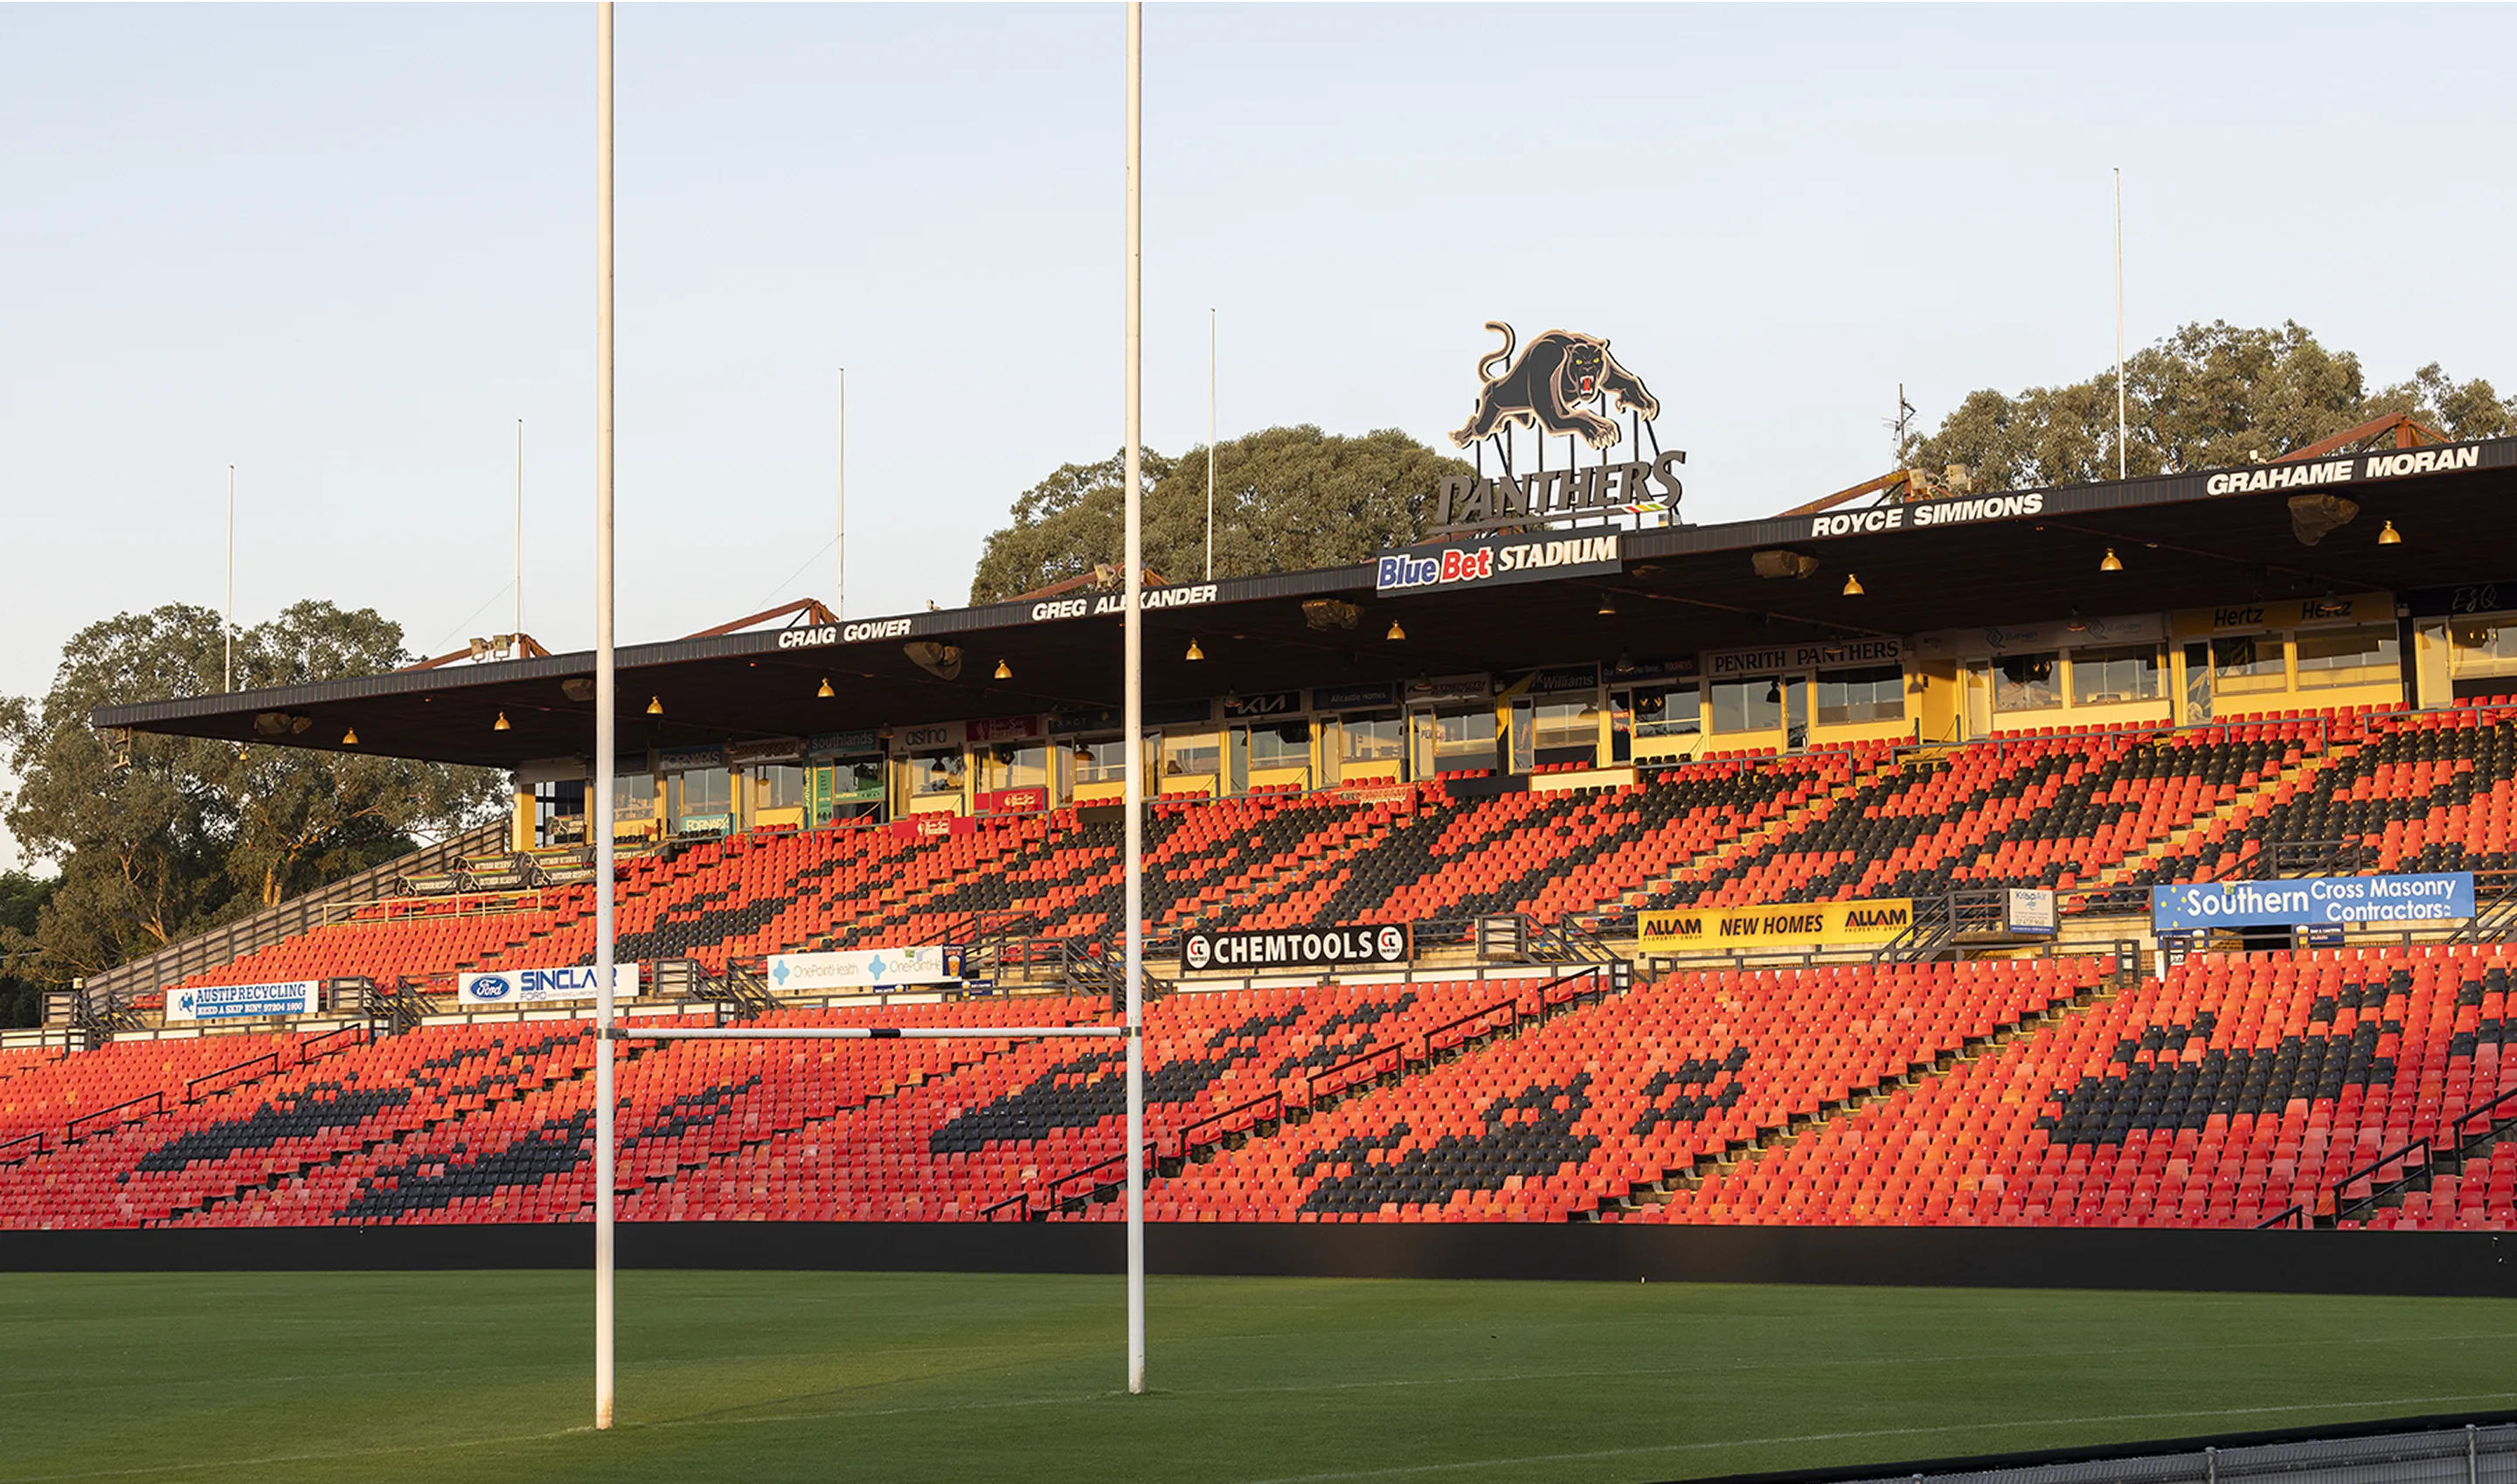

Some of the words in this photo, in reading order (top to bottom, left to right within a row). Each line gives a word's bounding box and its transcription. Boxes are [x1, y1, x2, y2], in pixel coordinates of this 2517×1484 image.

[2206, 460, 2354, 496] GRAHAME
[2366, 446, 2479, 478] MORAN
[1437, 450, 1686, 525] PANTHERS
[1811, 508, 1903, 537] ROYCE
[1914, 493, 2043, 525] SIMMONS
[1497, 536, 1618, 572] STADIUM
[1031, 599, 1087, 621] GREG
[2214, 607, 2264, 627] Hertz
[778, 626, 836, 648] CRAIG
[843, 619, 912, 641] GOWER
[1715, 650, 1786, 672] PENRITH
[1362, 691, 1387, 702] Homes
[811, 732, 874, 750] southlands
[2187, 886, 2309, 917] Southern
[2311, 881, 2364, 900] Cross
[2370, 878, 2457, 900] Masonry
[1845, 909, 1907, 927] ALLAM
[2326, 902, 2442, 922] Contractors
[1643, 919, 1702, 936] ALLAM
[1720, 919, 1759, 937] NEW
[1763, 914, 1824, 935] HOMES
[1214, 931, 1374, 963] CHEMTOOLS
[794, 962, 859, 978] OnePointHealth
[239, 983, 306, 1001] RECYCLING
[476, 978, 503, 996] Ford
[521, 967, 618, 991] SINCLAR
[519, 990, 546, 1001] FORD
